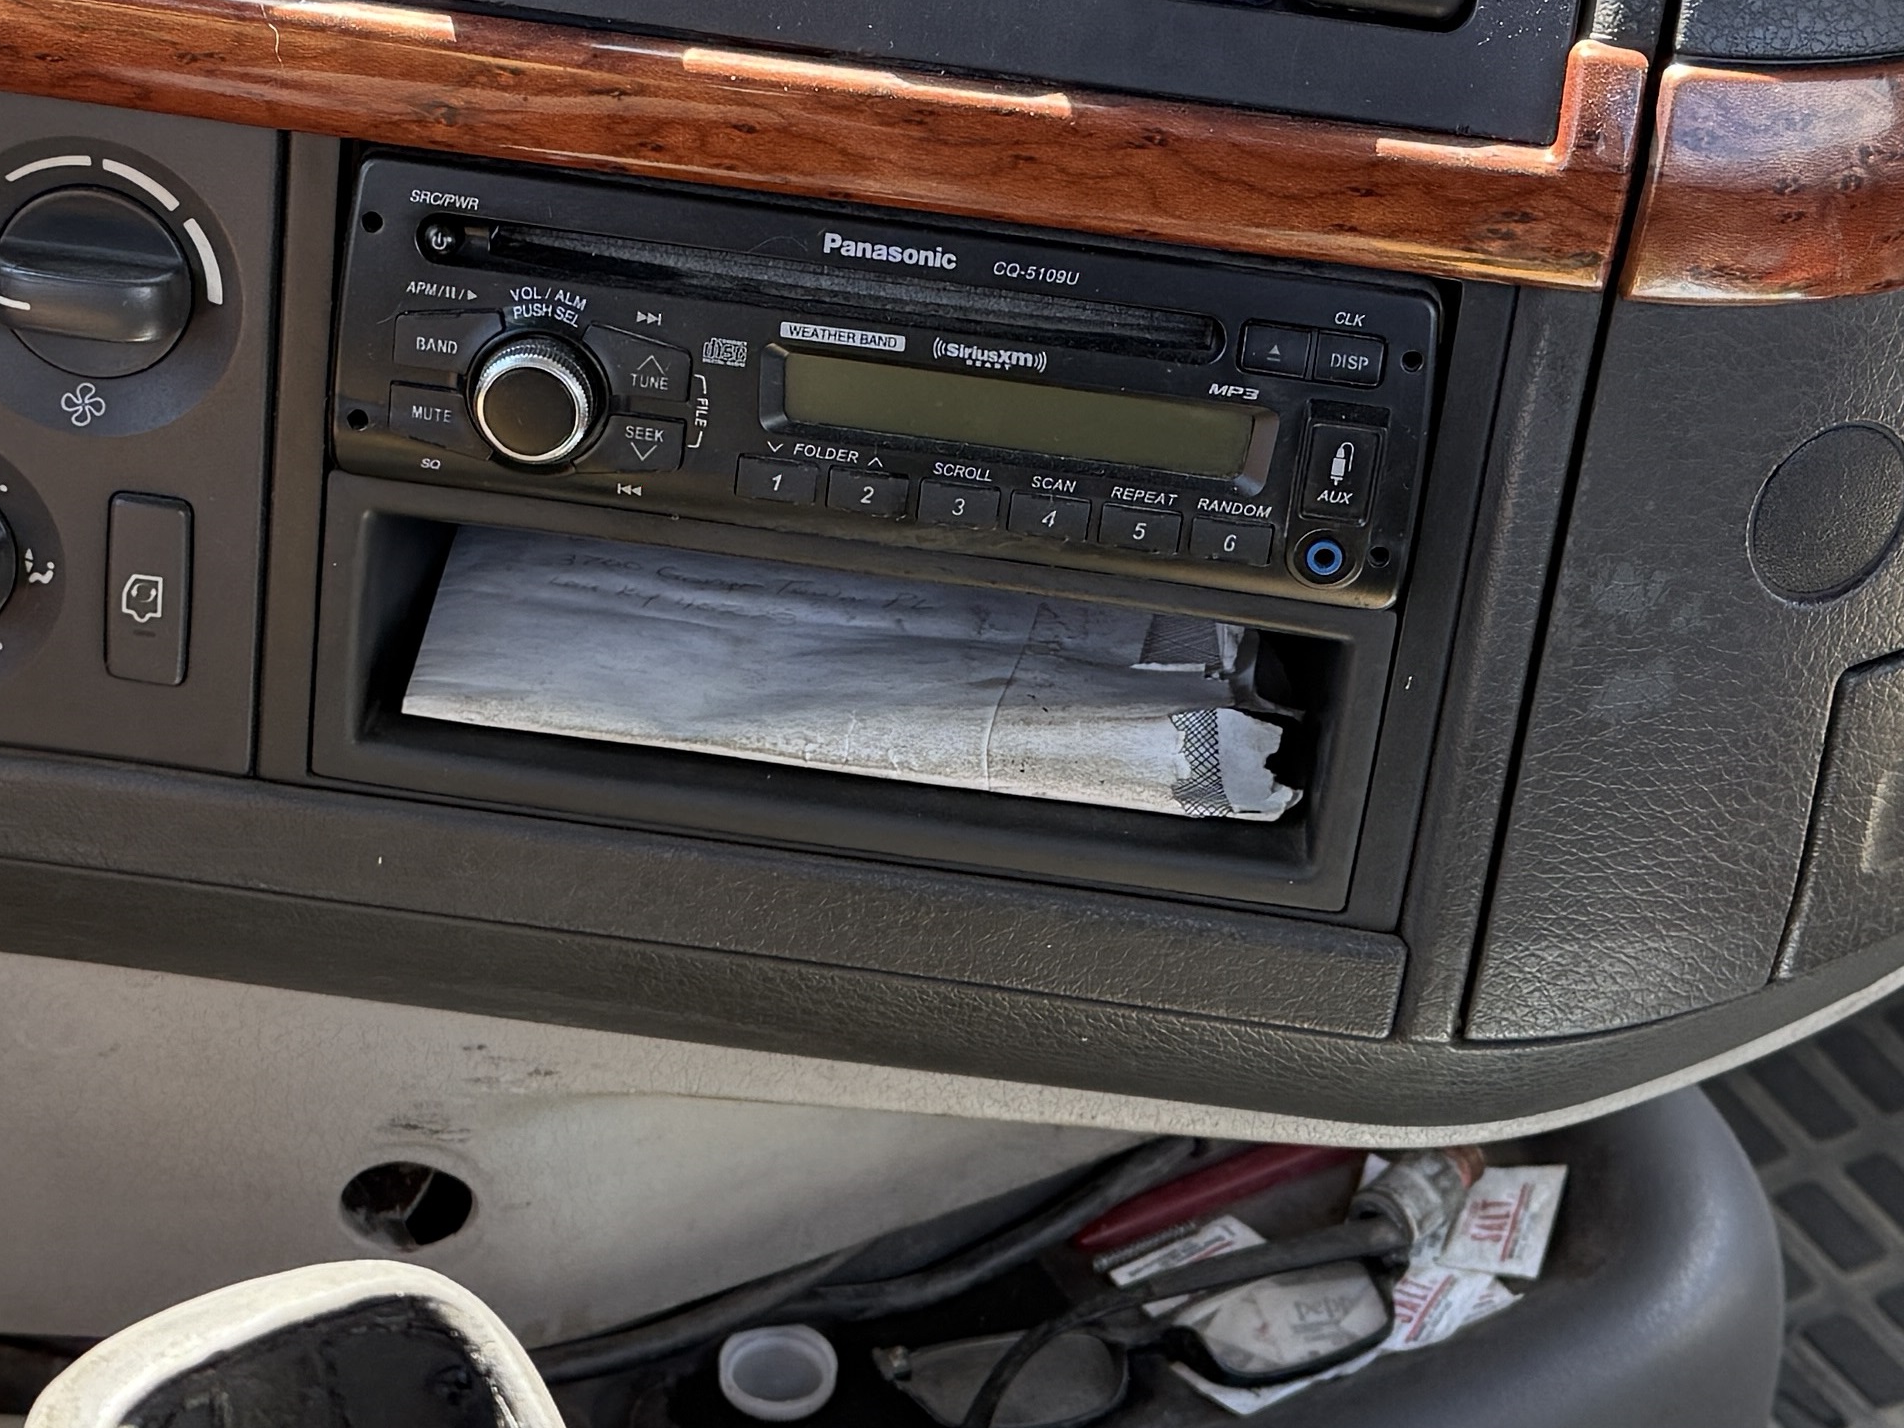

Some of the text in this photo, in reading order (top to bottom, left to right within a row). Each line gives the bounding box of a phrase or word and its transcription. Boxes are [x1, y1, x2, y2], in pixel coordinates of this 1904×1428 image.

[410, 189, 479, 210] SRC/PWR
[823, 232, 957, 270] Panasonic
[993, 261, 1079, 286] CQ-5109U
[510, 286, 541, 301] VOL
[555, 289, 587, 310] ALM
[513, 303, 580, 328] PUSH SEL
[1334, 311, 1365, 327] CLK
[789, 324, 897, 348] WEATHER BAND
[416, 337, 458, 355] BAND
[1330, 352, 1369, 370] DISP
[630, 373, 668, 390] TUNE
[1208, 383, 1260, 400] MP3
[412, 405, 452, 423] MUTE
[694, 397, 709, 428] FILE
[625, 426, 664, 442] SEEK
[793, 443, 859, 465] FOLDER
[420, 458, 441, 471] SQ
[933, 461, 993, 483] SCROLL
[772, 474, 783, 493] 1
[1031, 476, 1076, 493] SCAN
[860, 486, 875, 505] 2
[1111, 486, 1177, 507] REPEAT
[1317, 490, 1354, 505] AUX
[952, 497, 966, 516] 3
[1197, 498, 1272, 519] RANDOM
[1041, 509, 1057, 528] 4
[1133, 522, 1147, 541] 5
[1223, 533, 1237, 553] 6
